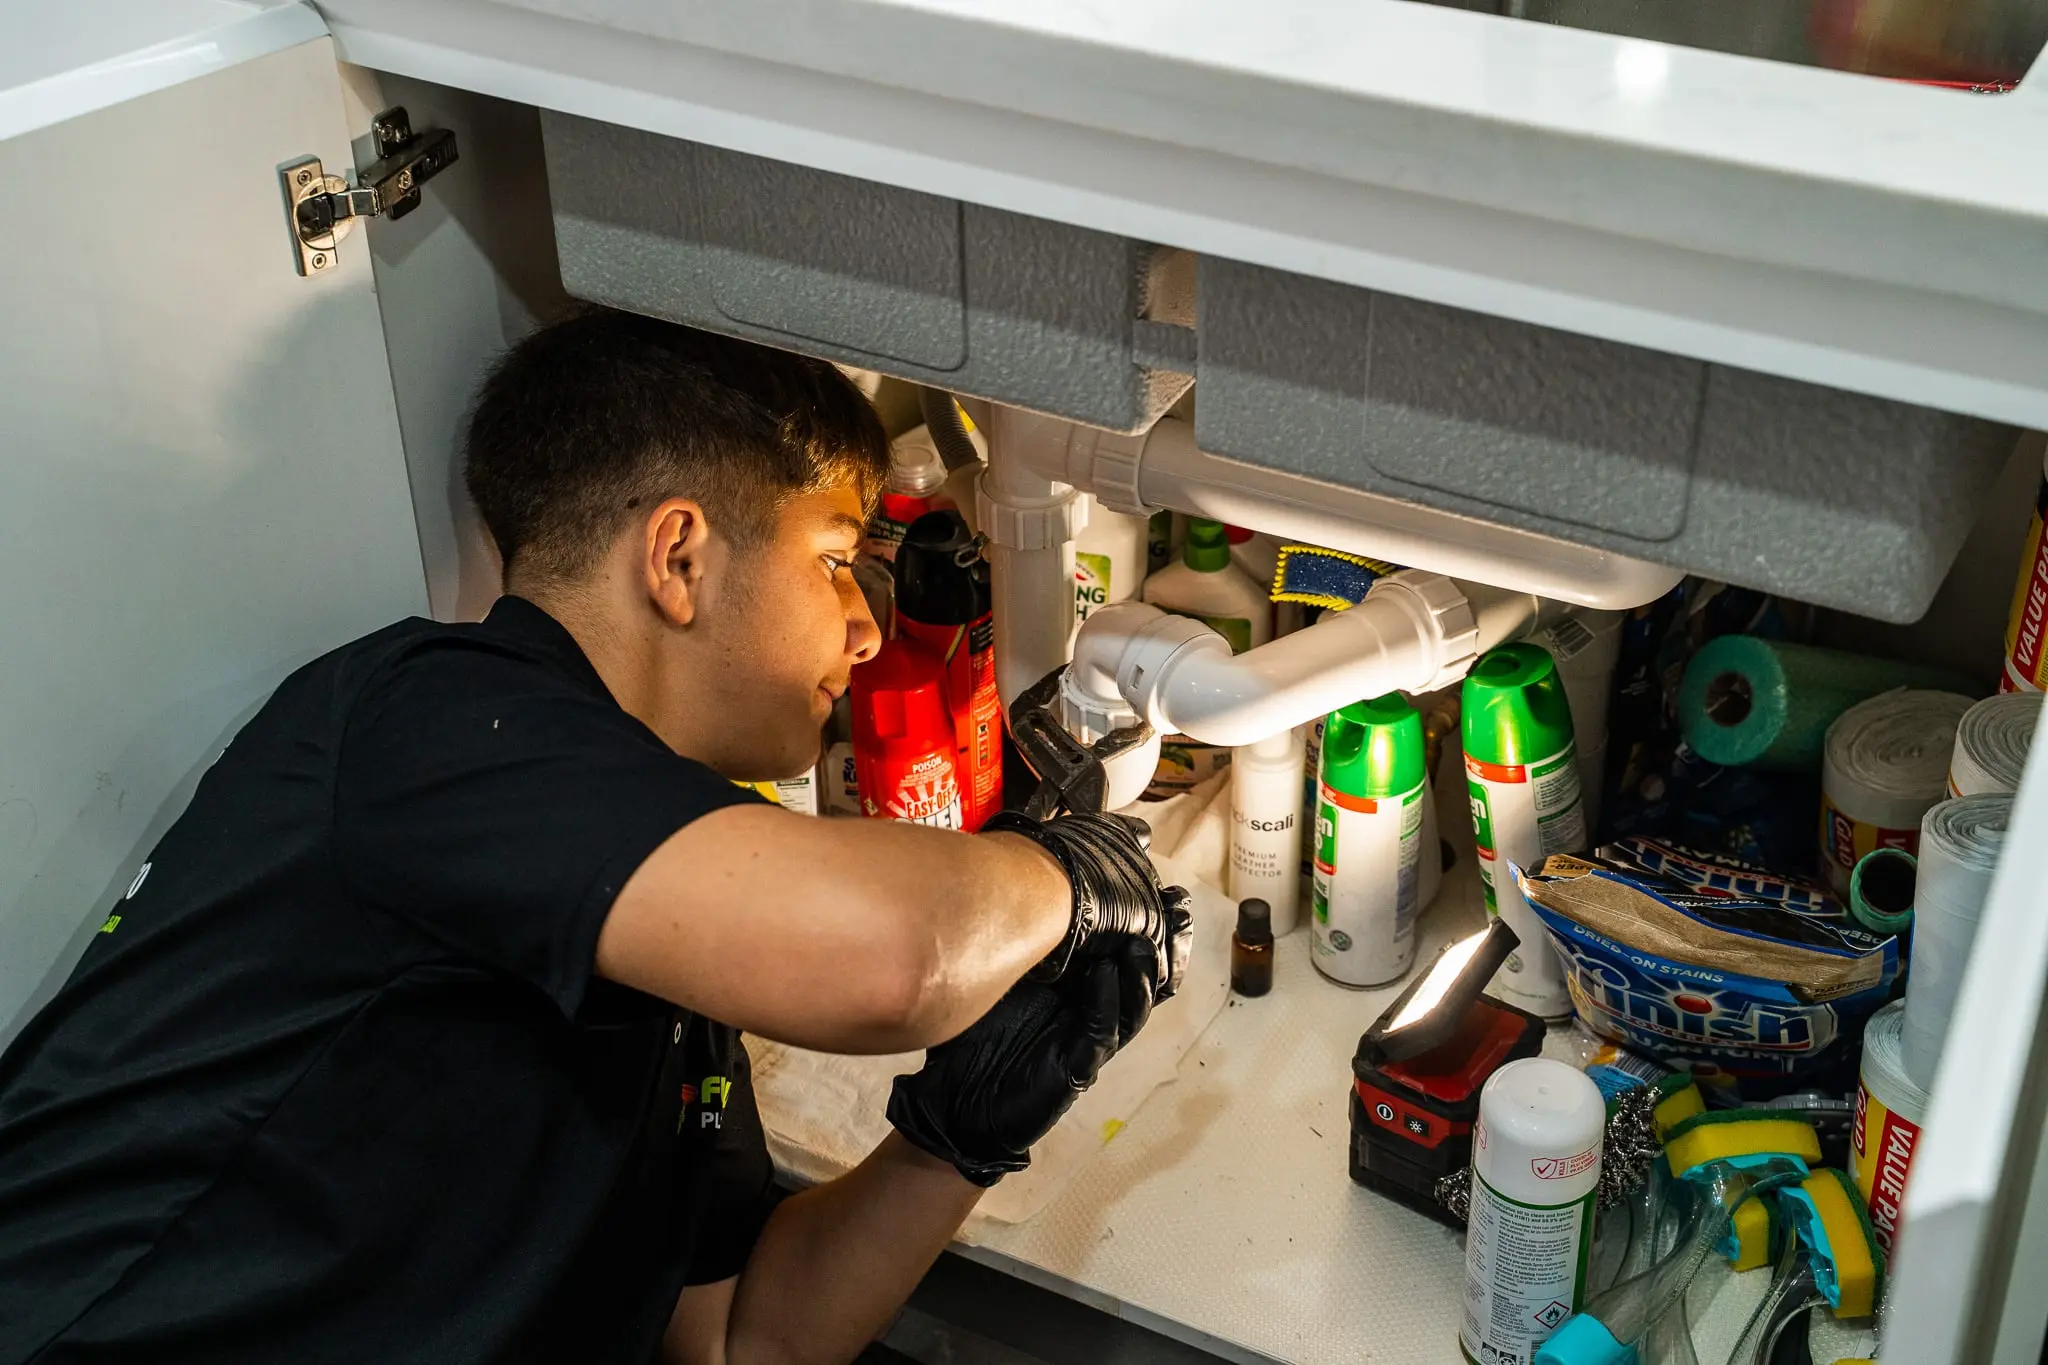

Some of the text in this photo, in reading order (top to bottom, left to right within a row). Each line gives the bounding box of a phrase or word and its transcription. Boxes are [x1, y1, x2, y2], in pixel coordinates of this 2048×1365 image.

[2016, 580, 2048, 667] VALUE
[912, 755, 943, 774] POISON
[1573, 925, 1725, 984] DRIED-ON STAINS
[1854, 1084, 1869, 1151] GLAD
[1873, 1123, 1914, 1262] VALUE PAC
